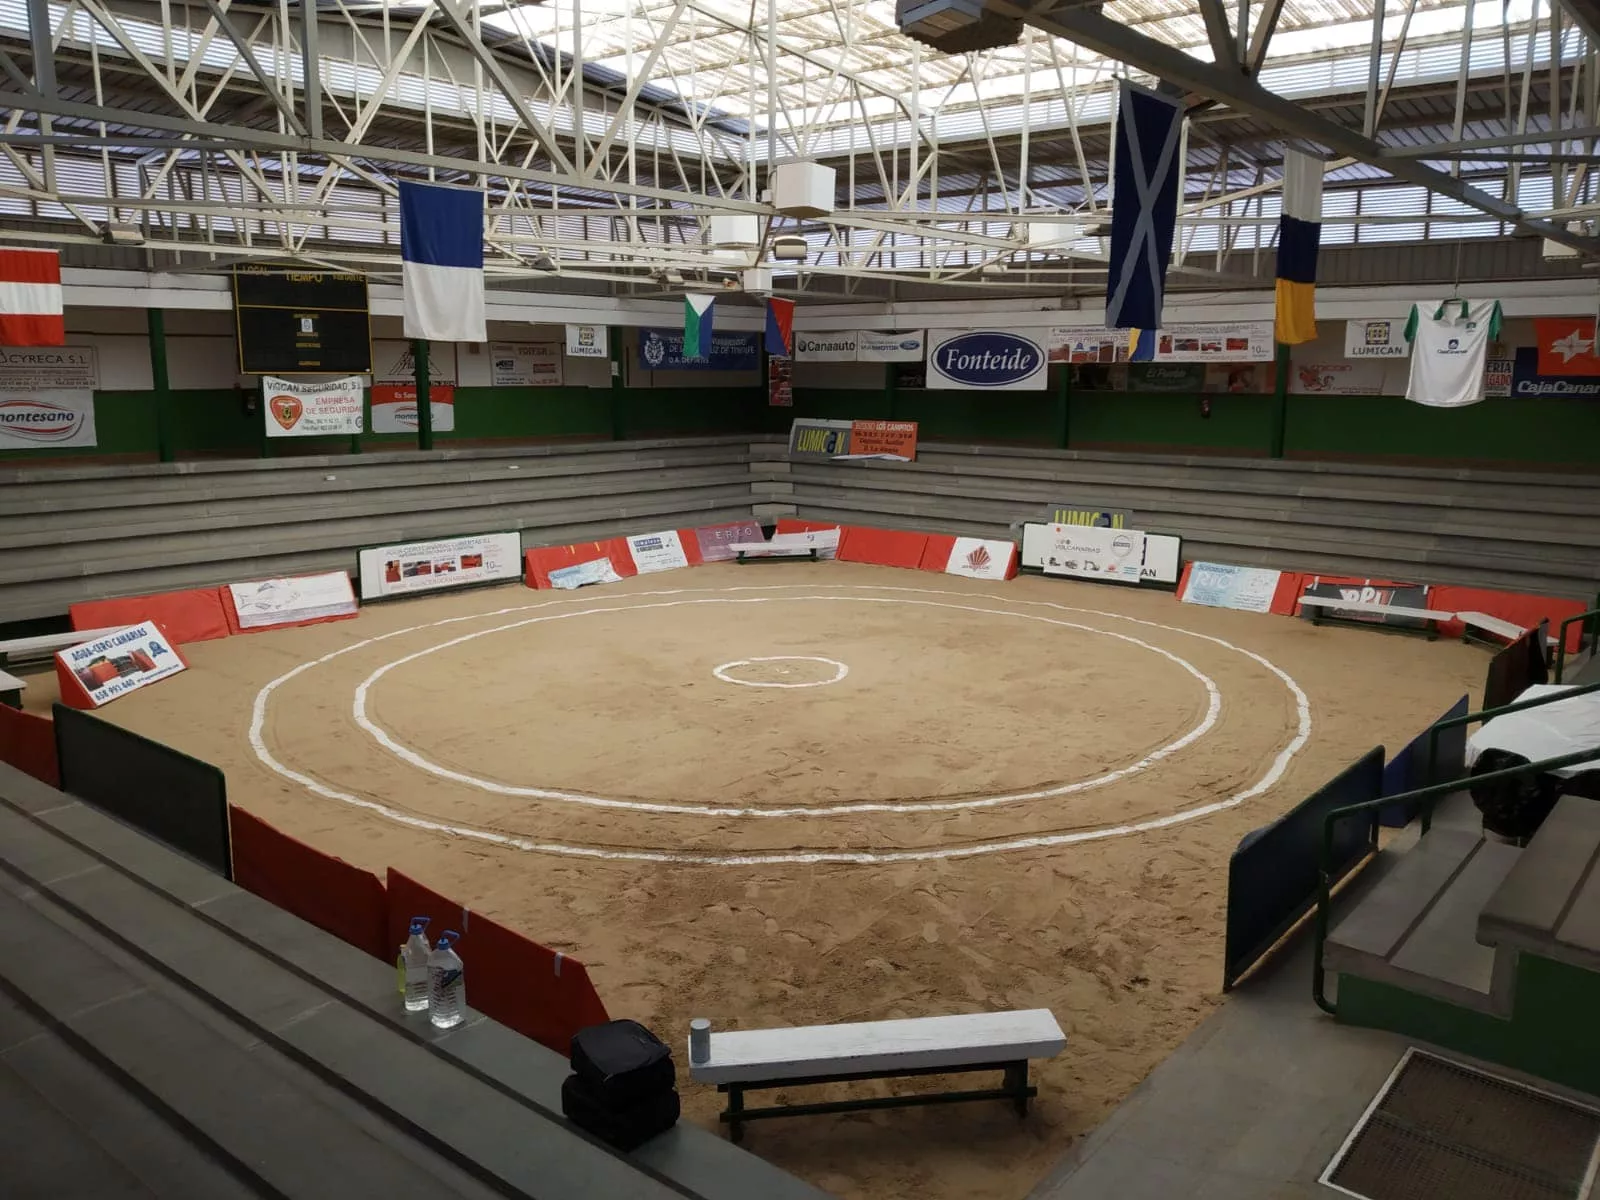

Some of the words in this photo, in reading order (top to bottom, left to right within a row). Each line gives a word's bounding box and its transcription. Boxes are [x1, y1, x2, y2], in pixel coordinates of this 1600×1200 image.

[570, 347, 606, 355] LUMICAN
[808, 341, 855, 352] Canaauto
[1352, 346, 1402, 355] LUMICAN
[945, 348, 1031, 370] Fonteide
[315, 397, 355, 405] EMPRESA
[306, 407, 318, 415] DE
[319, 405, 362, 414] SEGURIDA
[112, 627, 148, 647] CANARIAS
